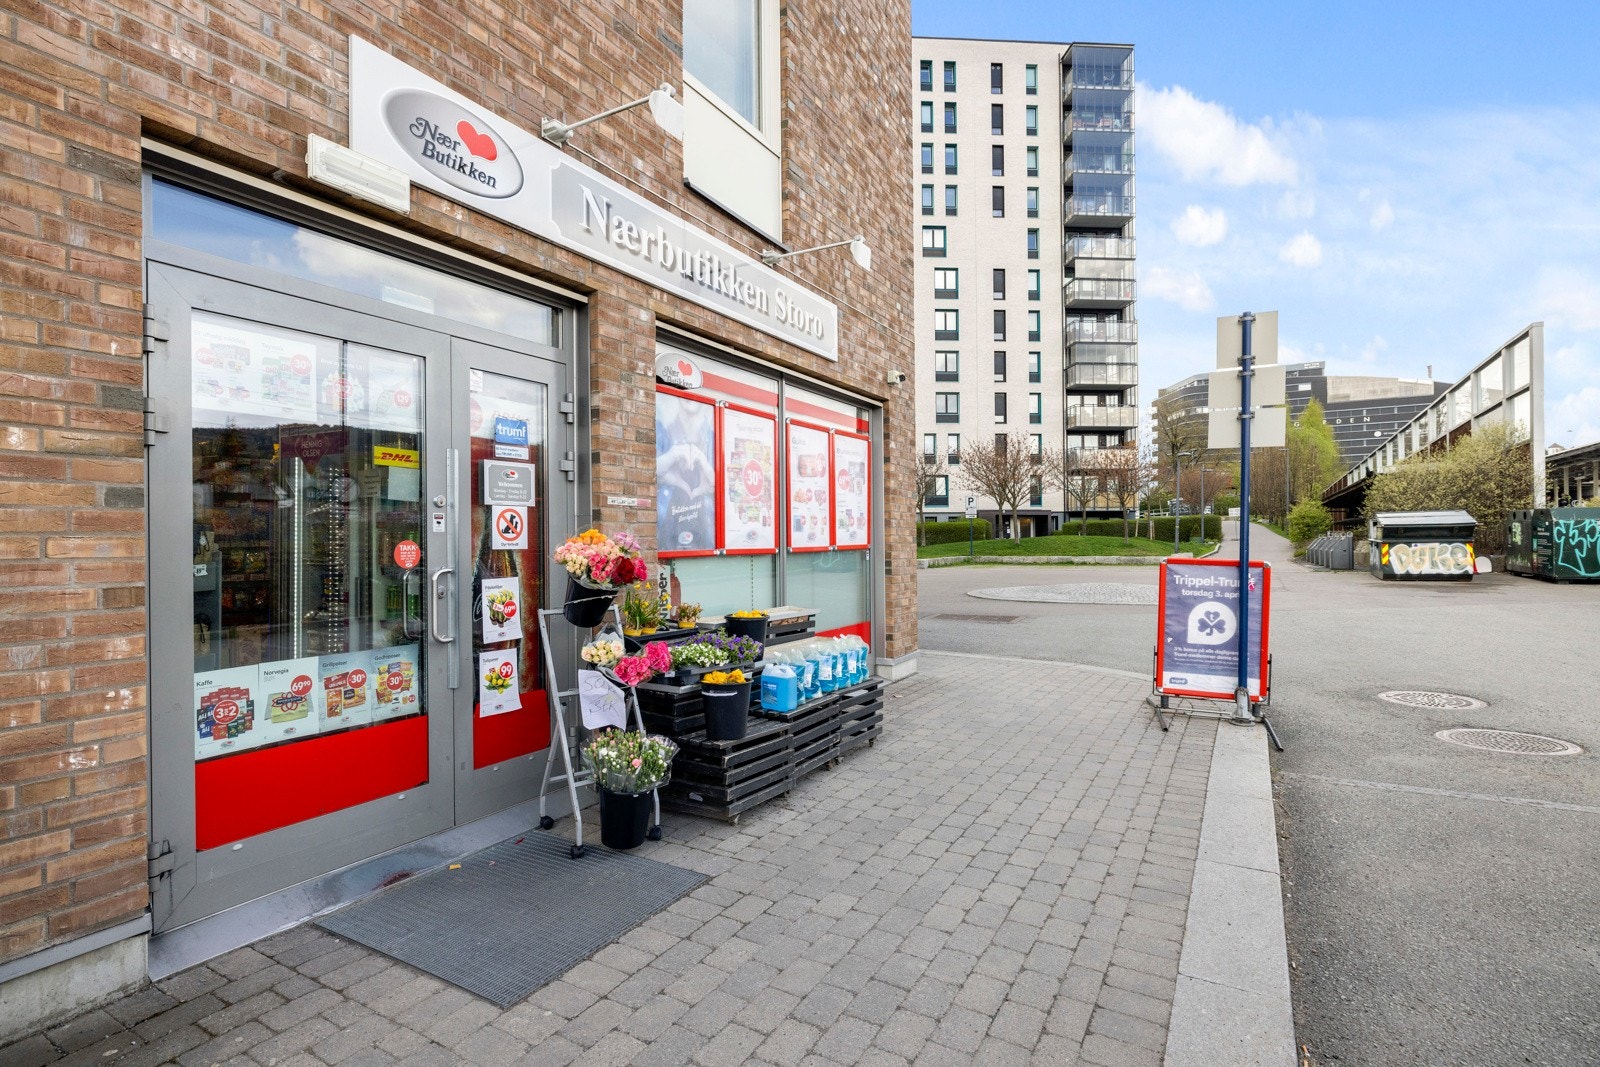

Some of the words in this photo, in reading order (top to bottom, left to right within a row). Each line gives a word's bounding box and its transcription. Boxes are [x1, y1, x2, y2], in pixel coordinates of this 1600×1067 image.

[409, 117, 461, 152] Nær
[420, 140, 498, 189] Butikken
[579, 183, 770, 316] Nærbutikken
[774, 289, 825, 339] Storo
[496, 423, 526, 438] trumf
[380, 452, 414, 463] DHL
[968, 497, 974, 506] P
[1181, 589, 1213, 599] torsdag
[1215, 590, 1223, 598] 3.
[500, 667, 512, 677] 99
